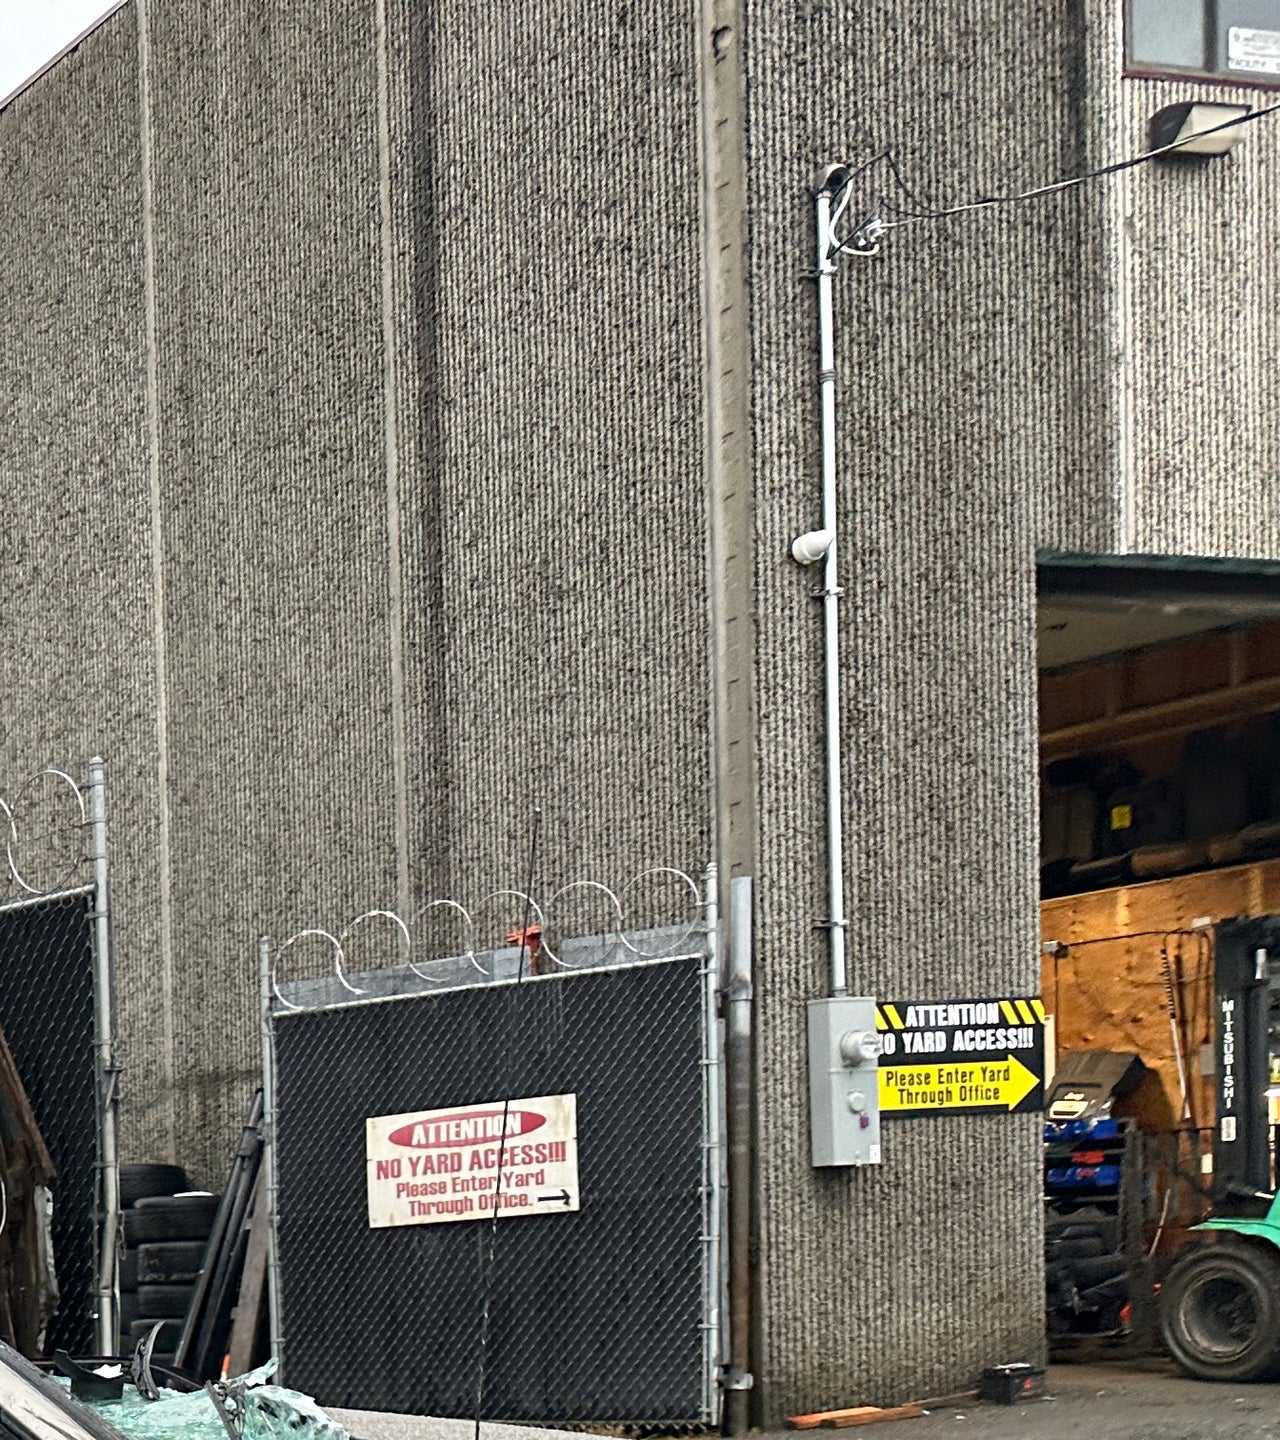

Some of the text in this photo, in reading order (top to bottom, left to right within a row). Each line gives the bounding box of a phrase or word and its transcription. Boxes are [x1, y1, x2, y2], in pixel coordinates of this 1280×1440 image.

[905, 1002, 1000, 1028] ATTENTION
[901, 1031, 947, 1054] YARD
[952, 1027, 1034, 1053] ACCESS!!!
[1221, 999, 1236, 1109] MITSUBISHI
[885, 1065, 1010, 1088] Please Enter Yard
[897, 1084, 1001, 1106] Through Office
[411, 1112, 522, 1146] ATTENTION
[376, 1141, 567, 1181] NO YARD ACCESS!!!
[396, 1168, 545, 1199] Please Enter Yard
[408, 1195, 474, 1217] Through
